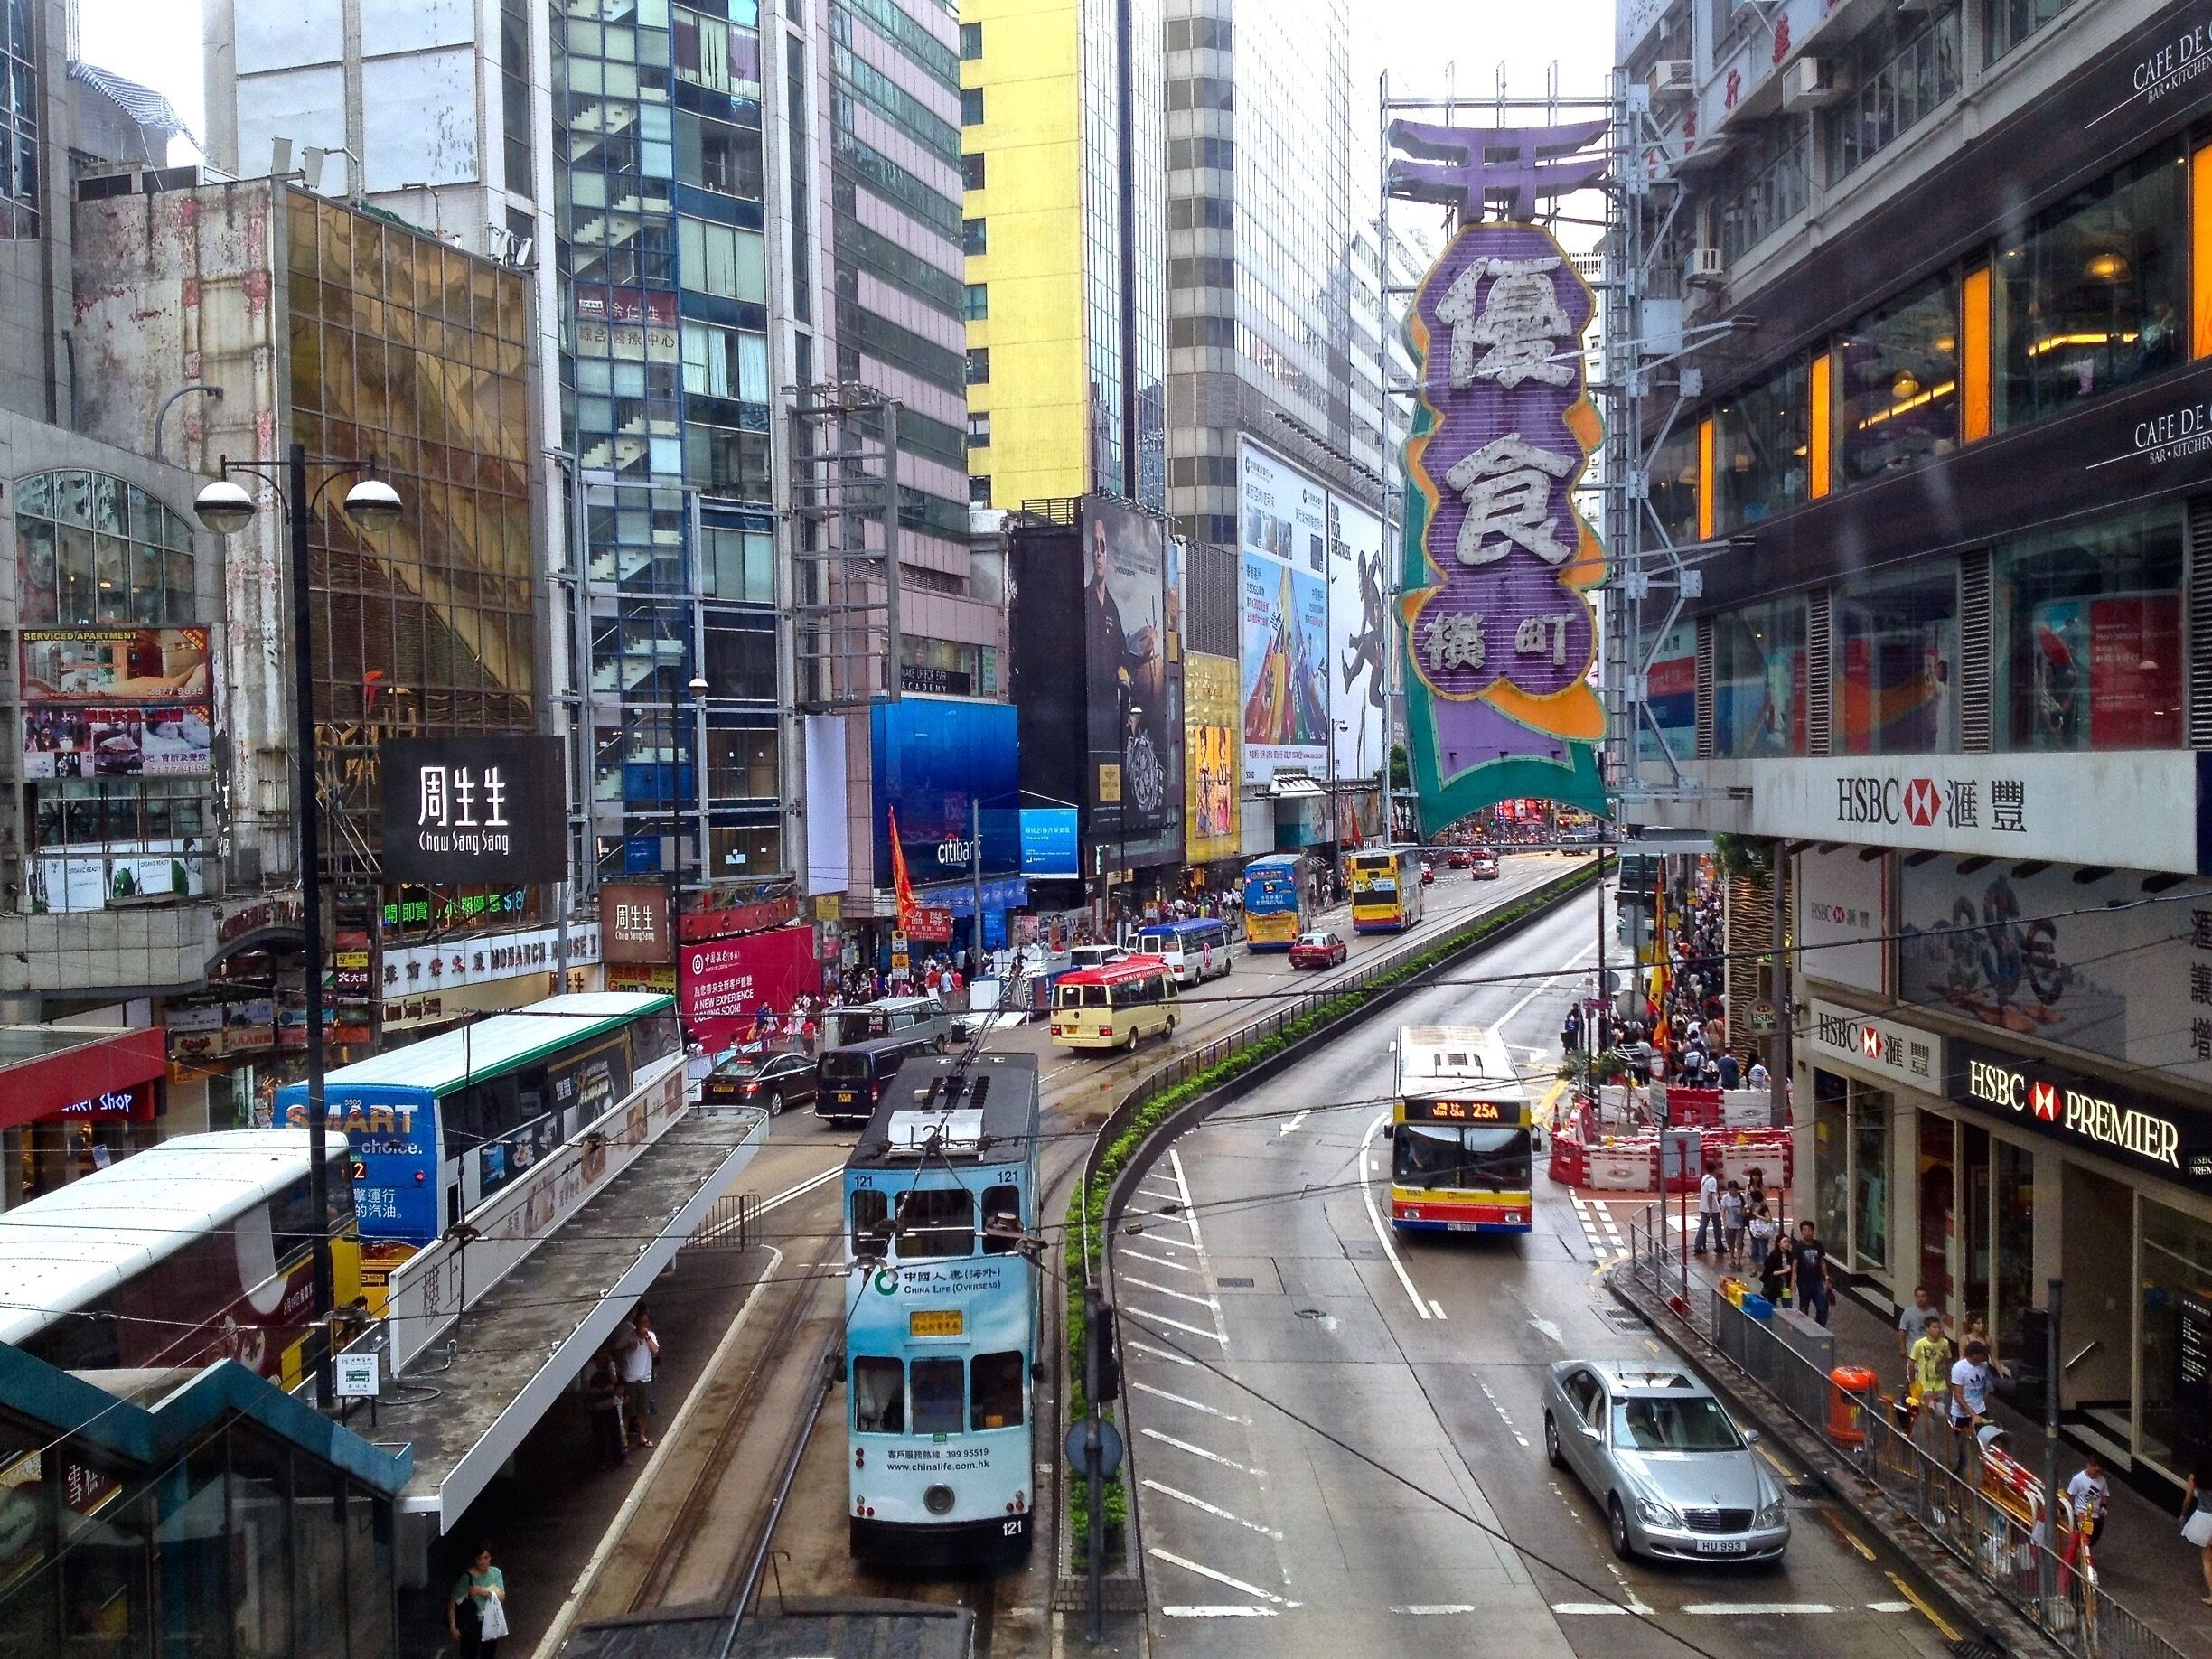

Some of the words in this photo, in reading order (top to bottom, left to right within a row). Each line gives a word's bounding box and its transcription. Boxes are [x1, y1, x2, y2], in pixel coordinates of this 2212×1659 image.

[2133, 44, 2173, 90] CAFE
[2179, 25, 2203, 63] DE
[2148, 83, 2164, 104] BAR
[612, 302, 661, 321] 余仁生
[2134, 413, 2174, 448] CAFE
[2180, 404, 2204, 435] DE
[2150, 448, 2167, 465] BAR
[23, 632, 74, 641] SERVICED
[76, 632, 138, 641] APARTMENT
[924, 670, 934, 680] FOR
[148, 688, 173, 696] 2877
[901, 681, 947, 693] ACADEMY
[418, 766, 508, 827] 周生生
[1836, 777, 1900, 825] HSBC
[418, 830, 449, 853] Chow
[452, 830, 479, 855] Sang
[481, 830, 509, 855] Sang
[615, 904, 653, 931] 周生生
[1811, 902, 1832, 923] HSBC
[629, 931, 642, 942] Sang
[642, 931, 655, 942] Sang
[491, 941, 546, 970] MONARCH
[550, 935, 586, 961] HUSE
[693, 1000, 699, 1012] A
[699, 997, 716, 1010] NEW
[716, 989, 755, 1007] EXPERIENCE
[721, 1003, 741, 1016] SOON!
[1750, 1012, 1777, 1022] HSBC
[1818, 1012, 1858, 1053] HSBC
[1472, 1103, 1499, 1119] 25A
[1969, 1060, 2025, 1112] HSBC
[2065, 1089, 2179, 1169] PREMIER
[854, 1176, 873, 1187] 121
[997, 1170, 1018, 1183] 121
[904, 1285, 930, 1294] CHINA
[933, 1285, 951, 1294] LIFE
[946, 1450, 961, 1458] 399
[963, 1448, 989, 1457] 95519
[886, 1460, 990, 1472] www.chinalife.com.hk
[1002, 1520, 1022, 1536] 121
[1702, 1542, 1717, 1551] HU
[1720, 1542, 1741, 1551] 993
